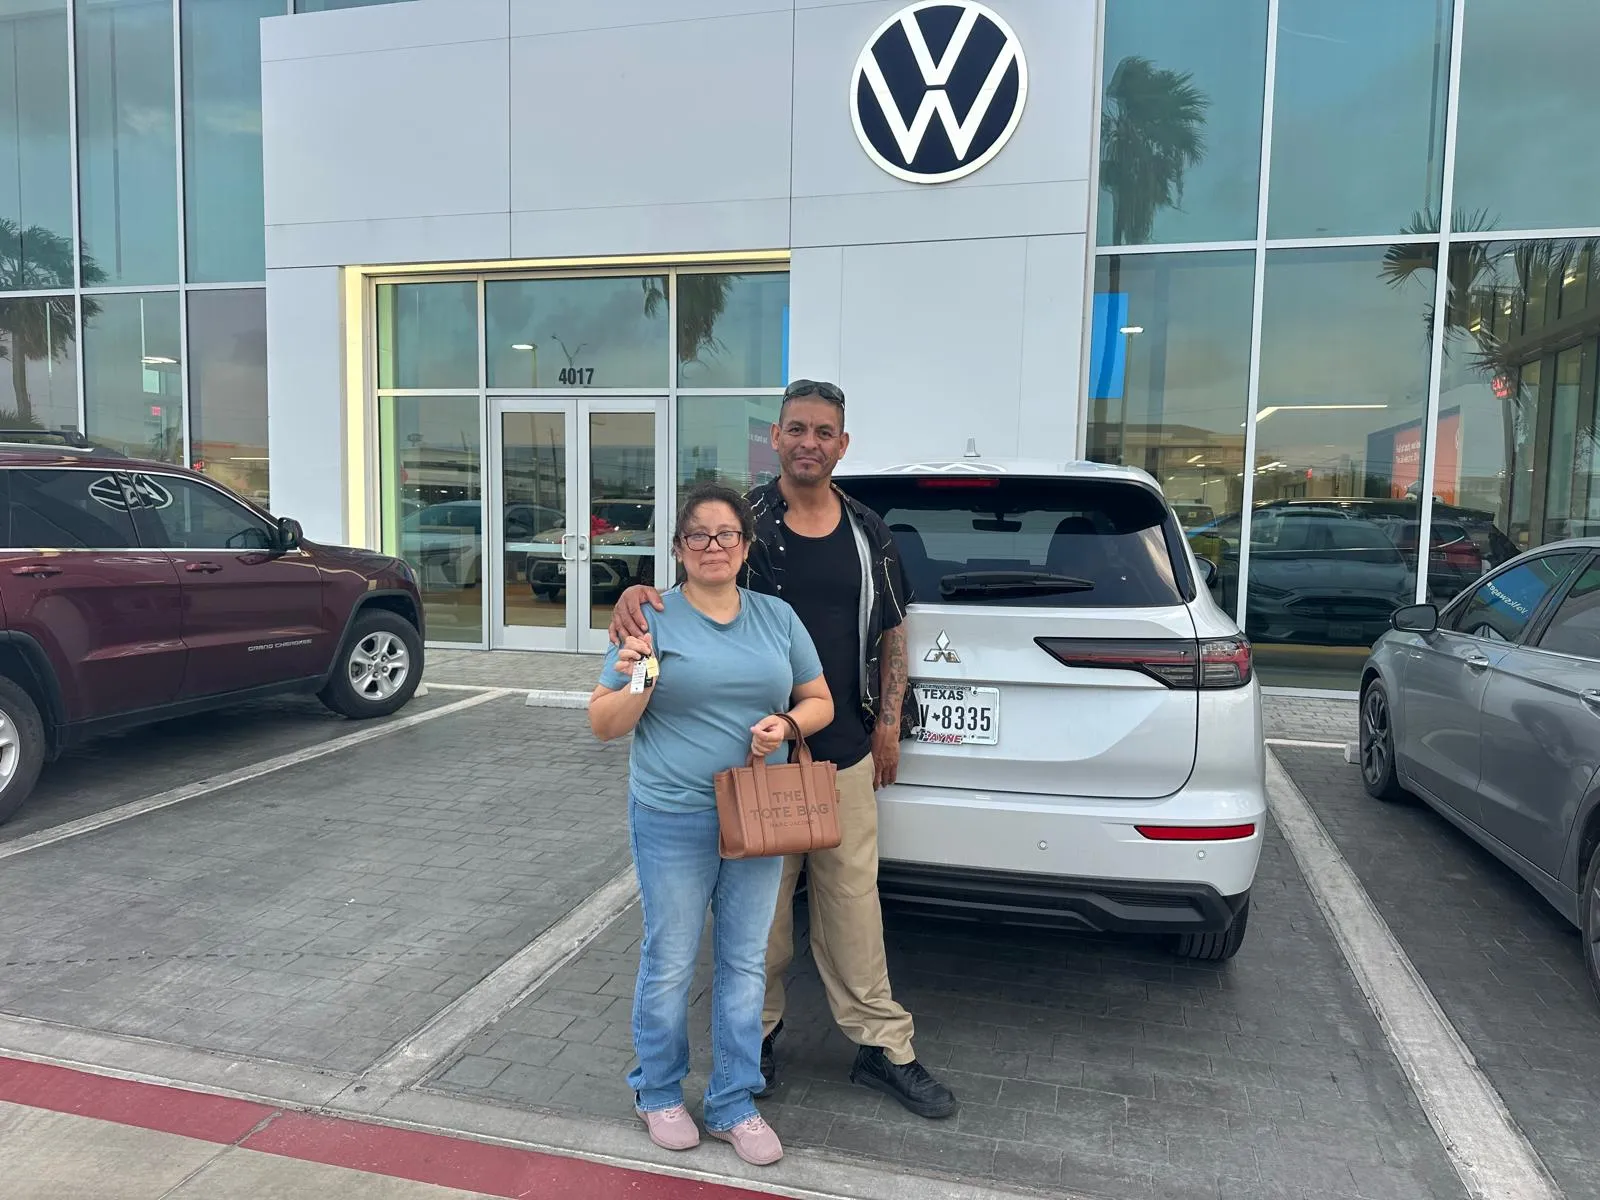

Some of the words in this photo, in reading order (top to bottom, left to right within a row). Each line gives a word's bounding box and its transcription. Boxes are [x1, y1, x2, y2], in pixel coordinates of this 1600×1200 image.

[849, 0, 1028, 185] VW
[559, 367, 595, 385] 4017
[248, 643, 274, 651] GRAND
[922, 688, 964, 700] TEXAS
[772, 790, 803, 804] THE
[749, 805, 792, 820] TOTE
[796, 803, 829, 817] BAG
